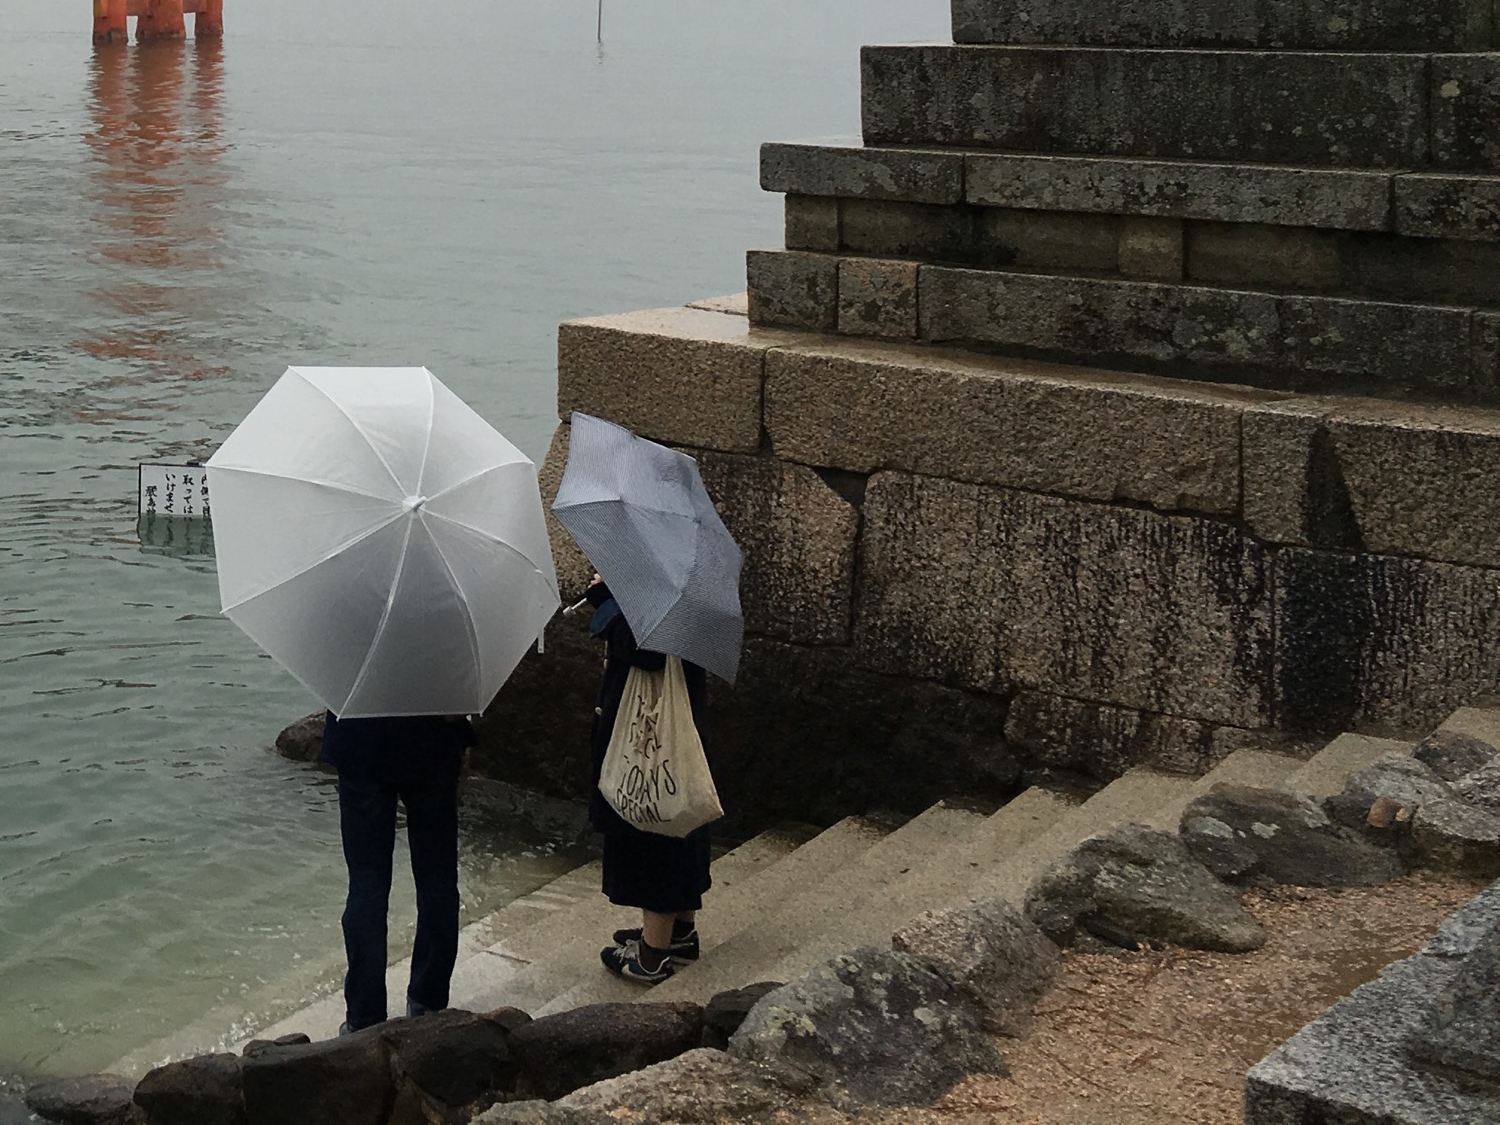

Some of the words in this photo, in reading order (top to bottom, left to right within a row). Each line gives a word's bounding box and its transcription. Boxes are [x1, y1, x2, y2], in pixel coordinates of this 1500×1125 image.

[182, 474, 195, 514] 取っては
[613, 788, 672, 824] SPECIAL
